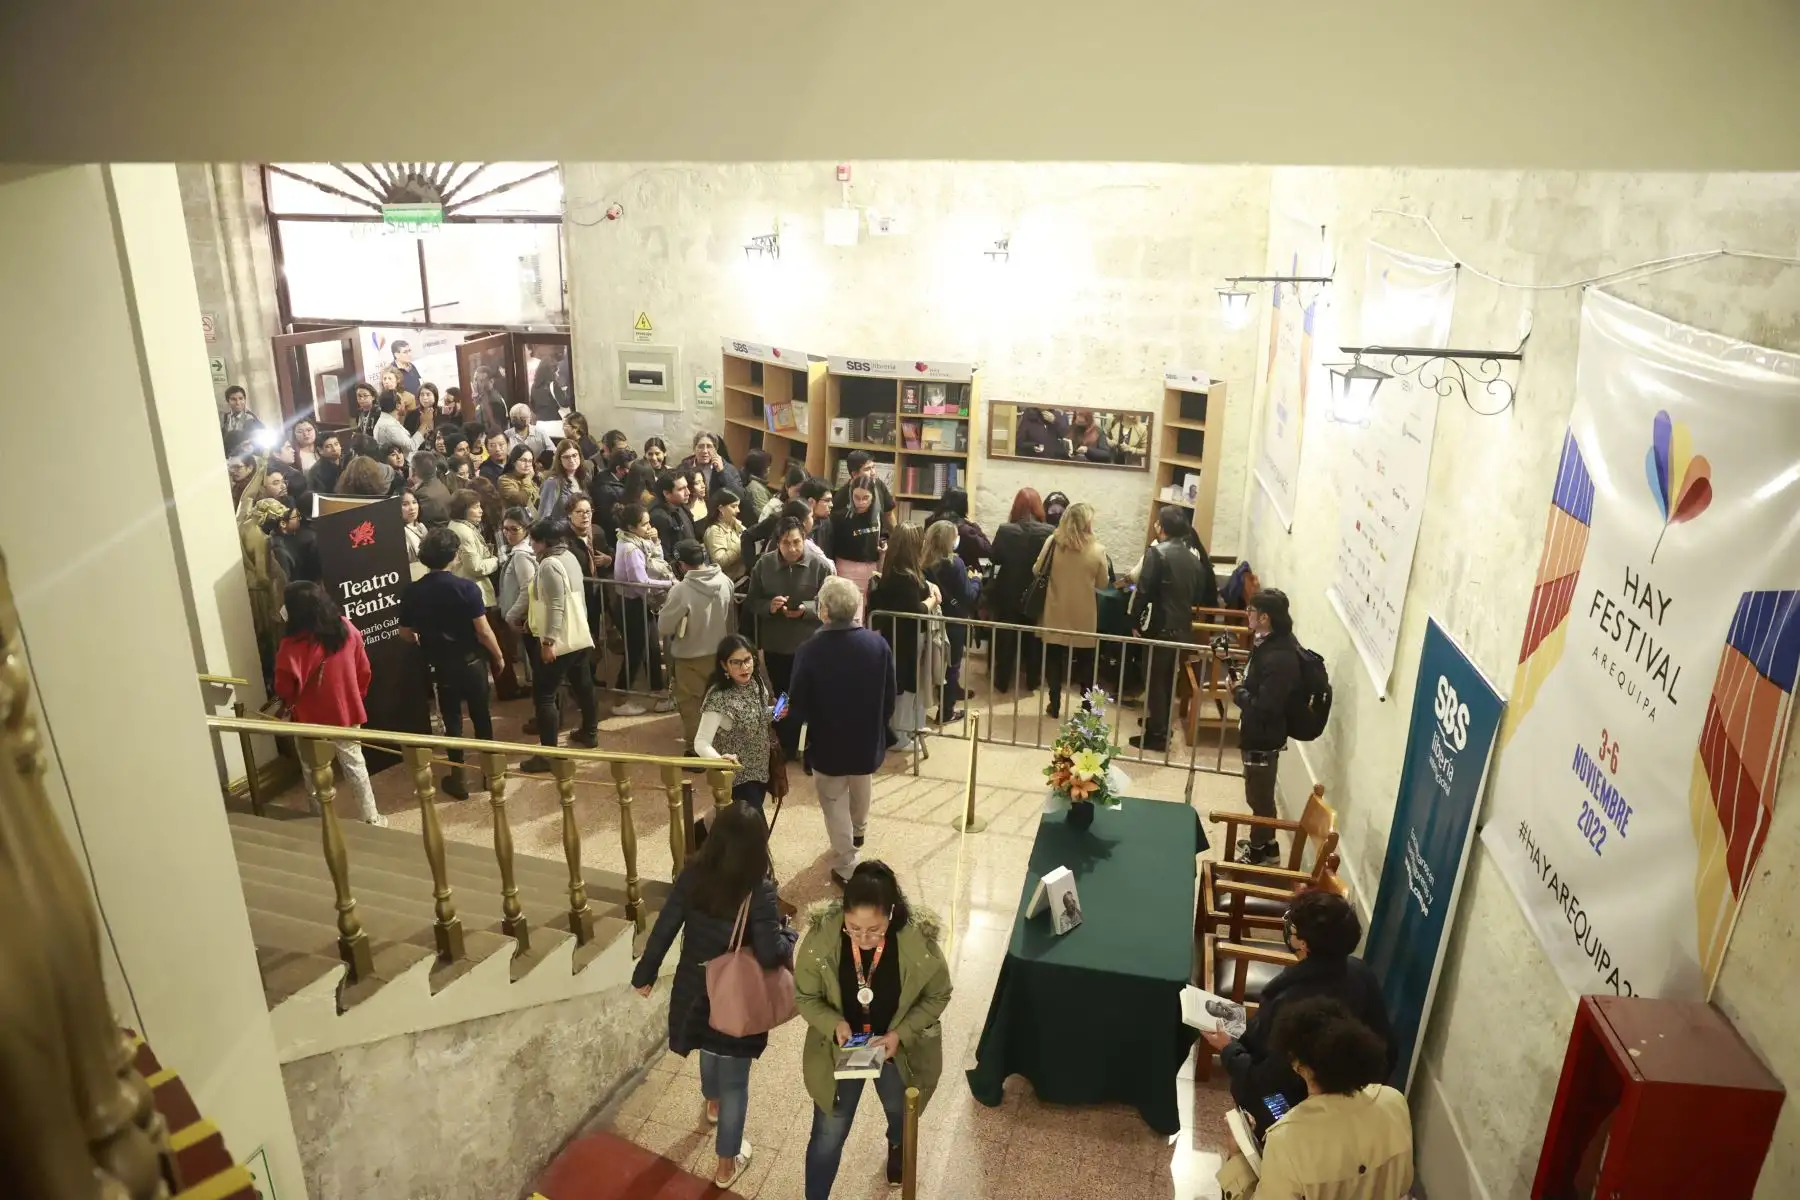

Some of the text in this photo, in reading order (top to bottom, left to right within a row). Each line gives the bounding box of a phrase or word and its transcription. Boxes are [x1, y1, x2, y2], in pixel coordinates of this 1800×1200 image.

[846, 360, 871, 372] SBS
[339, 571, 400, 599] Teatro
[343, 592, 401, 620] Fénix.
[1623, 566, 1672, 626] HAY
[360, 623, 382, 636] nario
[381, 628, 399, 640] Cym
[1589, 589, 1681, 705] FESTIVAL
[1592, 646, 1655, 722] AREQUIPA
[1434, 675, 1470, 751] SBS
[1599, 728, 1619, 774] 3-6
[1572, 743, 1633, 839] NOVIEMBRE
[1577, 800, 1607, 857] 2022
